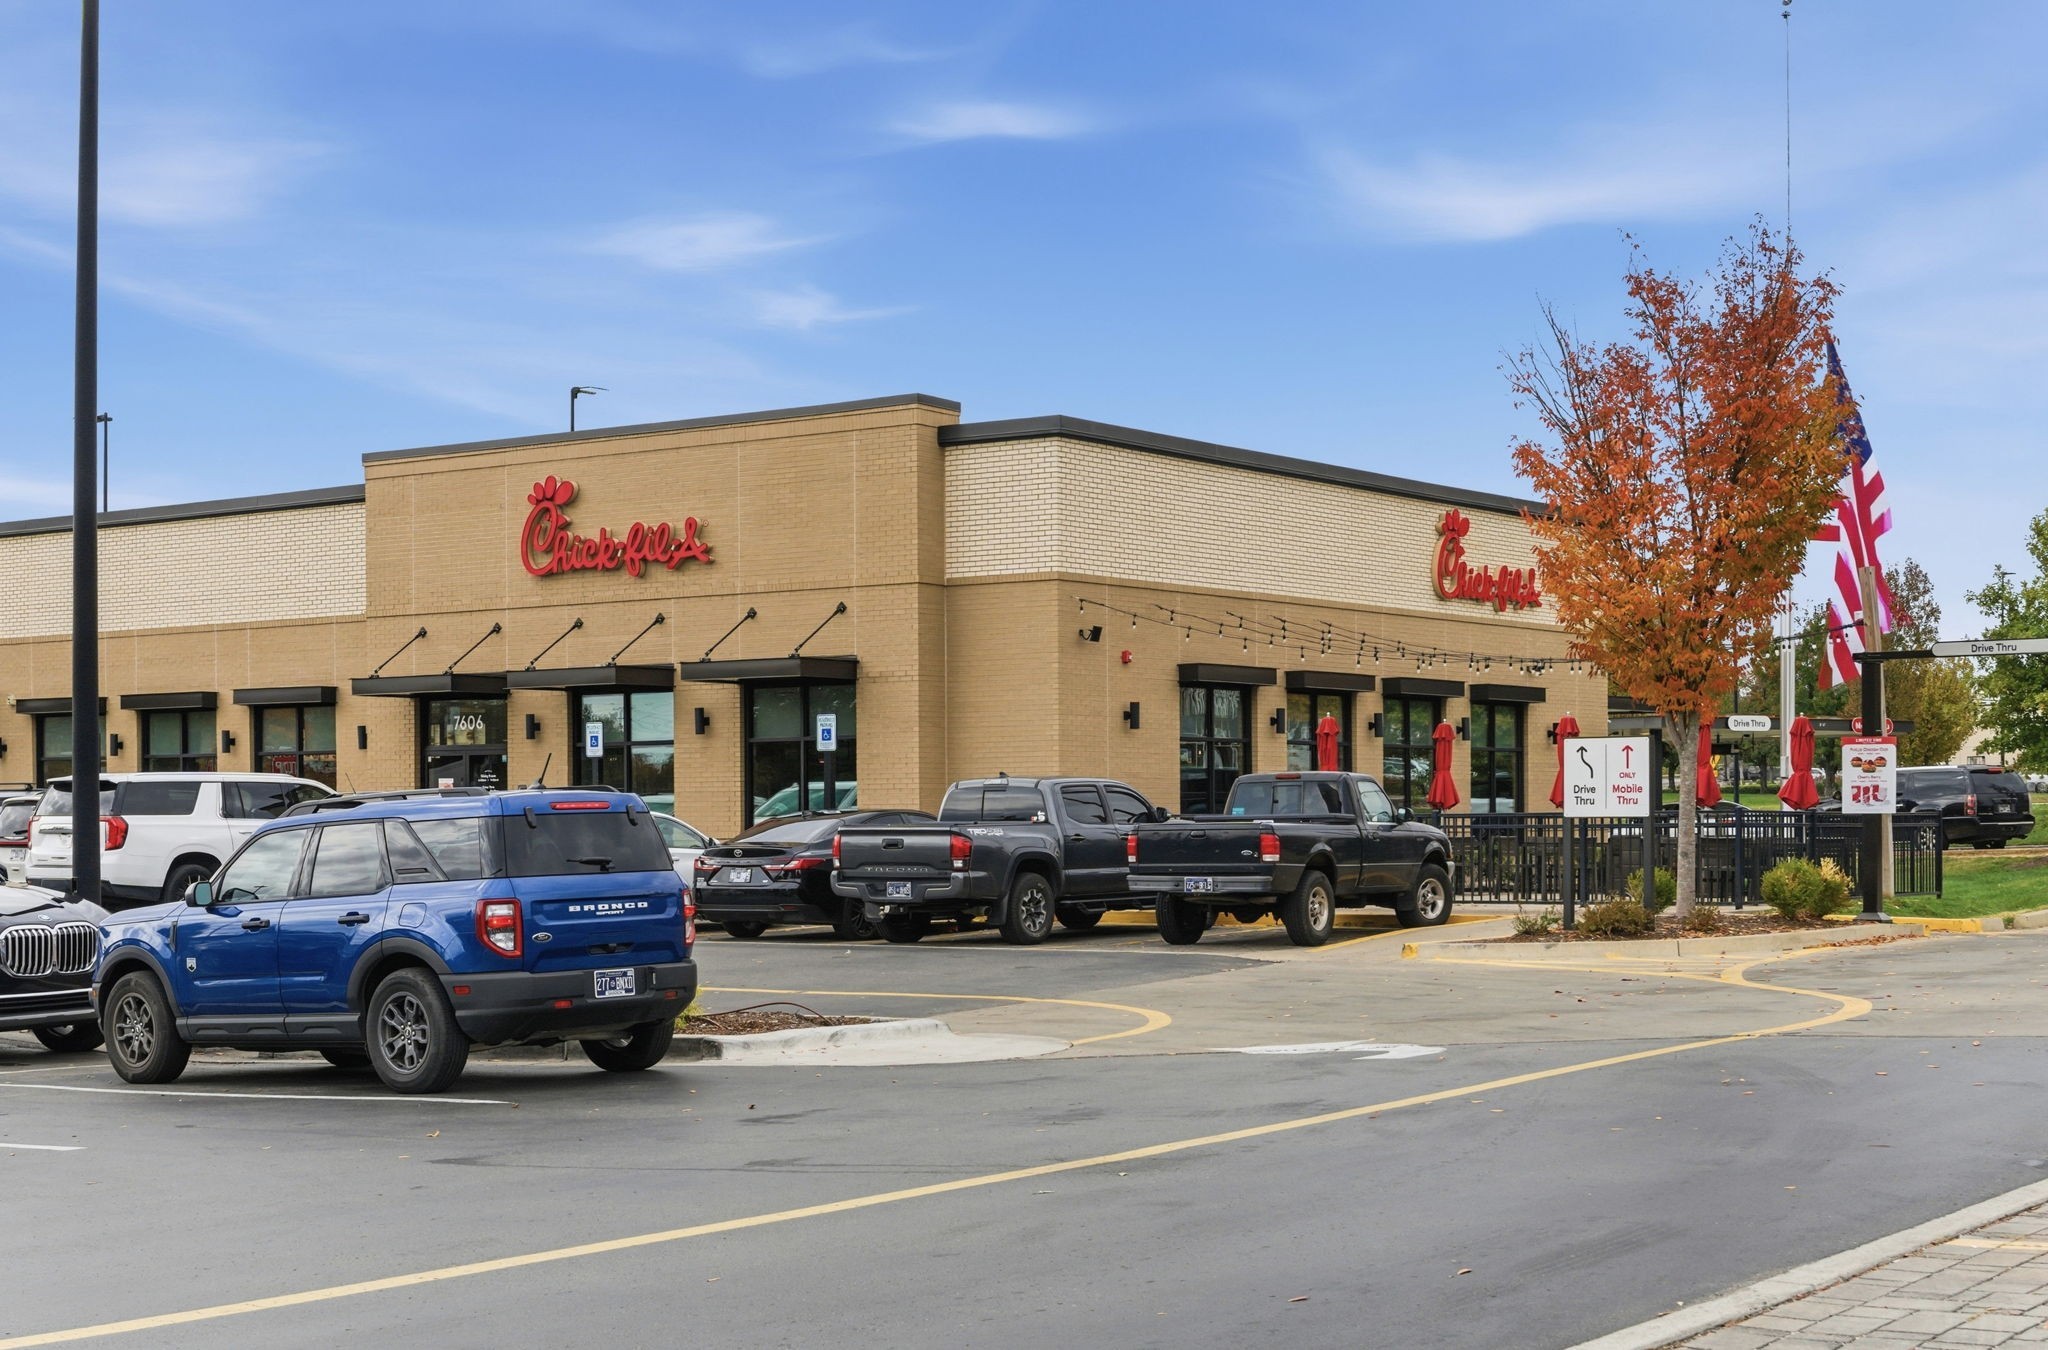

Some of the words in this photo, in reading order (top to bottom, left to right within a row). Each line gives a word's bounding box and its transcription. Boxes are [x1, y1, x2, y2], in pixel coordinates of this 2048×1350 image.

[521, 475, 711, 577] Chick-fil-A
[1438, 508, 1542, 612] Chick-fil-A
[1971, 644, 1994, 653] Drive
[1996, 643, 2017, 651] Thru
[453, 714, 484, 730] 7606
[1573, 785, 1596, 793] Drive
[1612, 784, 1643, 793] Mobile
[1574, 796, 1595, 805] Thru
[1616, 796, 1638, 805] Thru
[568, 902, 648, 912] BRONCO
[597, 977, 610, 991] 277
